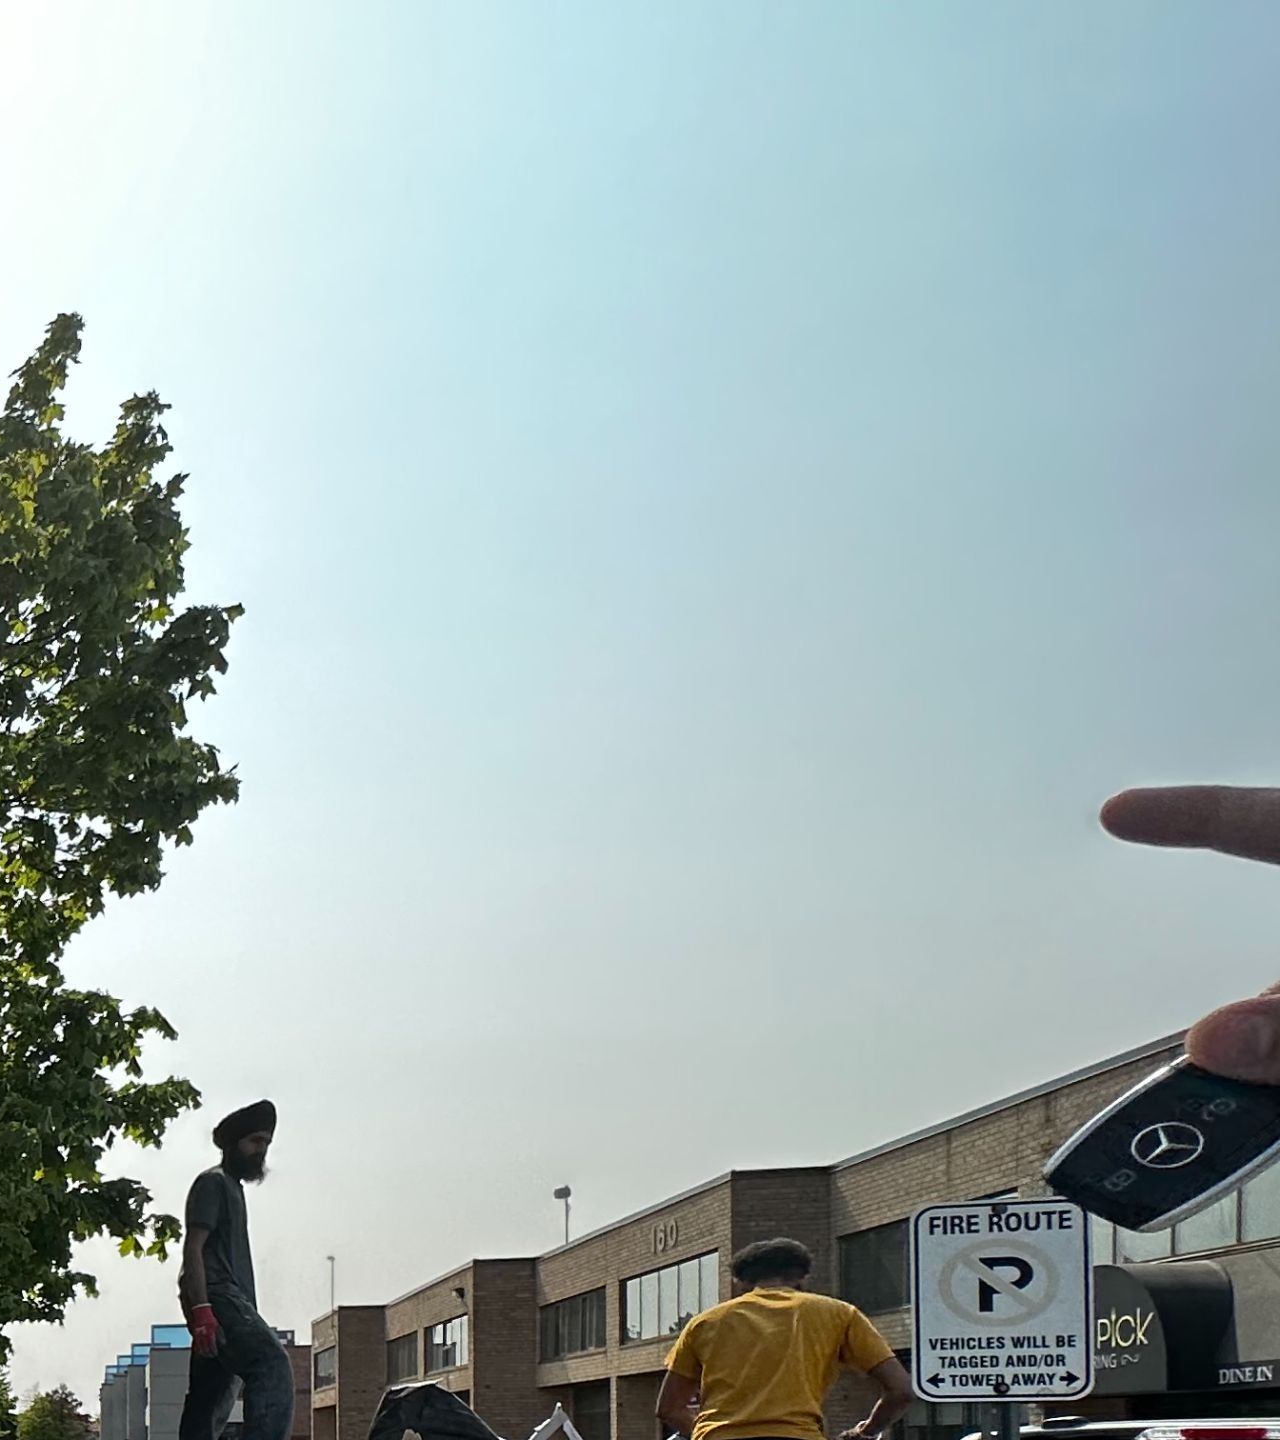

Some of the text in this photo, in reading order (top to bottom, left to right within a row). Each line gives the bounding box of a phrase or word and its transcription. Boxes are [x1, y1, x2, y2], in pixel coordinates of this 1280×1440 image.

[928, 1210, 1073, 1236] FIRE ROUTE
[651, 1219, 679, 1255] 160
[928, 1334, 1077, 1350] VEHICLES WILL BE
[938, 1354, 1066, 1369] TAGGED AND/OR
[949, 1373, 1056, 1387] TOWED AWAY
[1218, 1365, 1274, 1384] DINE IN
